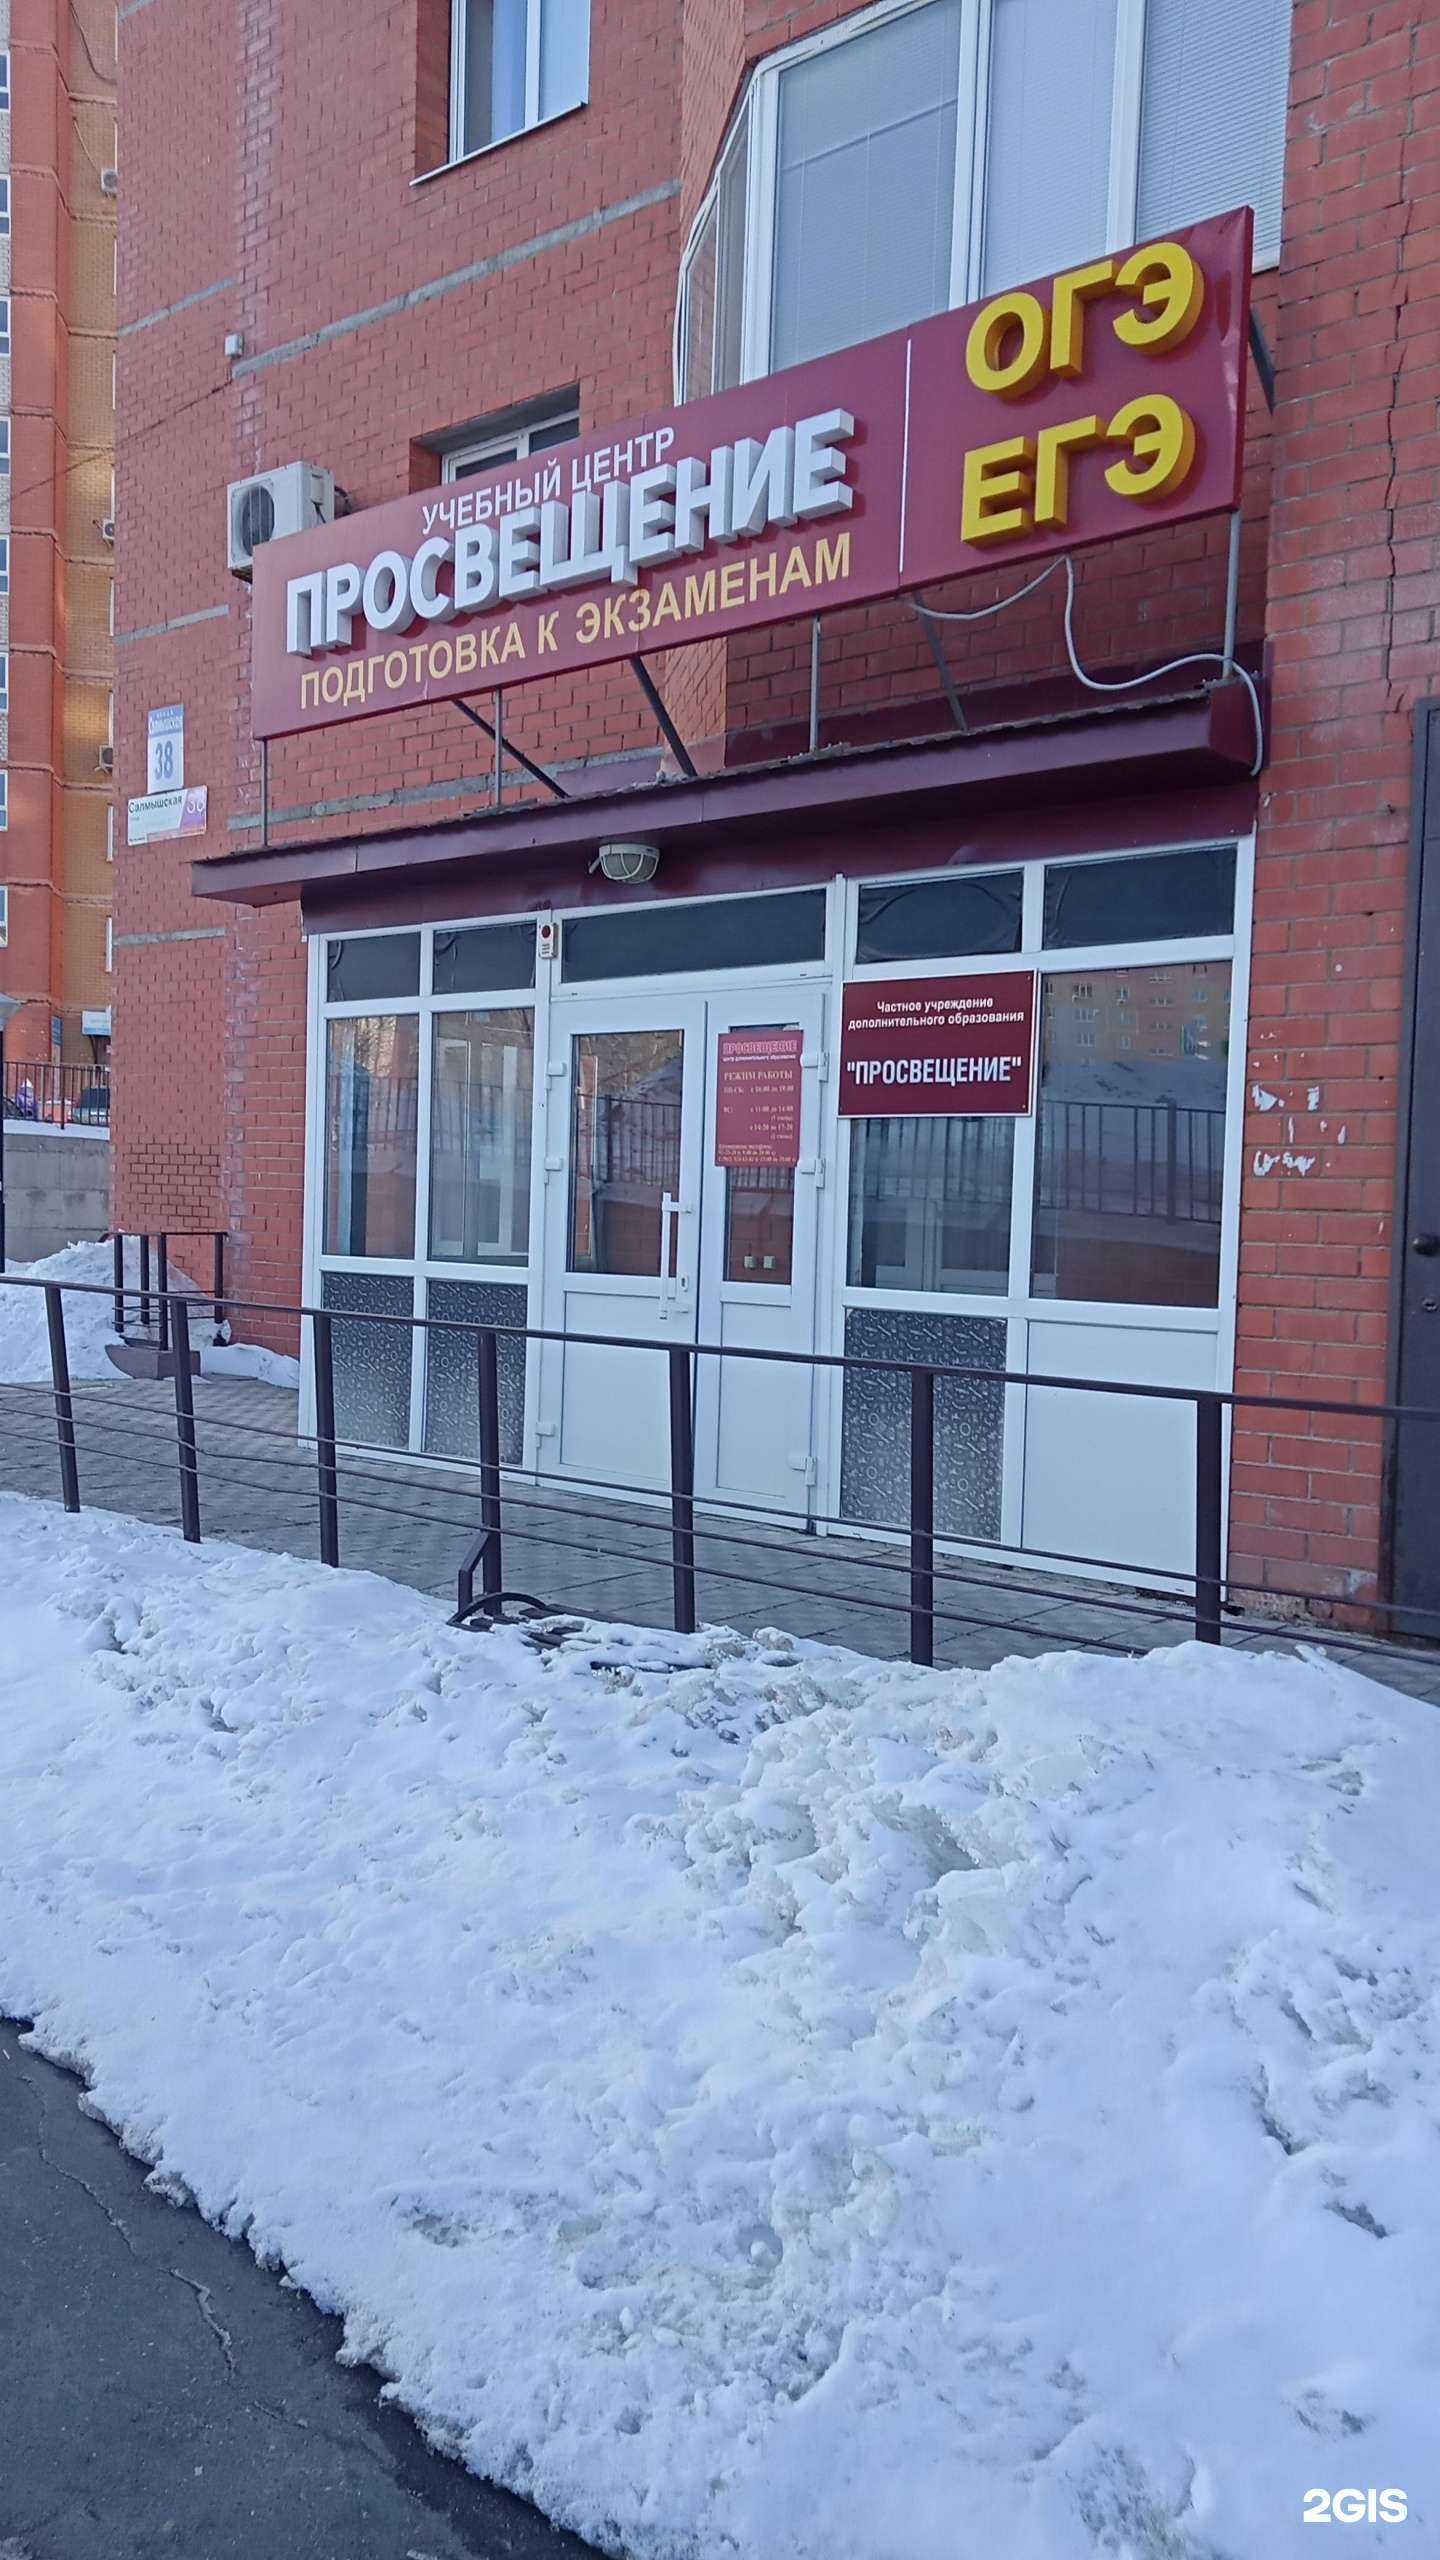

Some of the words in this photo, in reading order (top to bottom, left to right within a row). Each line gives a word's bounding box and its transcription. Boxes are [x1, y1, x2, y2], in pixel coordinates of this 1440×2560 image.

[966, 242, 1204, 399] ОГЭ
[421, 457, 562, 535] УЧЕБНЫЙ
[571, 426, 675, 494] ЦЕНТР
[960, 394, 1196, 548] ЕГЭ
[286, 408, 855, 657] ПРОСВЕЩЕНИЕ
[301, 621, 526, 710] ПОДГОТОВКА
[537, 610, 560, 655] К
[575, 532, 851, 645] ЭКЗАМЕНАМ
[154, 740, 174, 781] 38
[128, 795, 183, 815] Салмышская
[848, 1015, 945, 1031] дополнительного
[948, 1011, 1025, 1027] образования
[877, 1000, 922, 1014] Частное
[924, 997, 993, 1013] учреждение
[847, 1056, 1022, 1087] "ПРОСВЕЩЕНИЕ"
